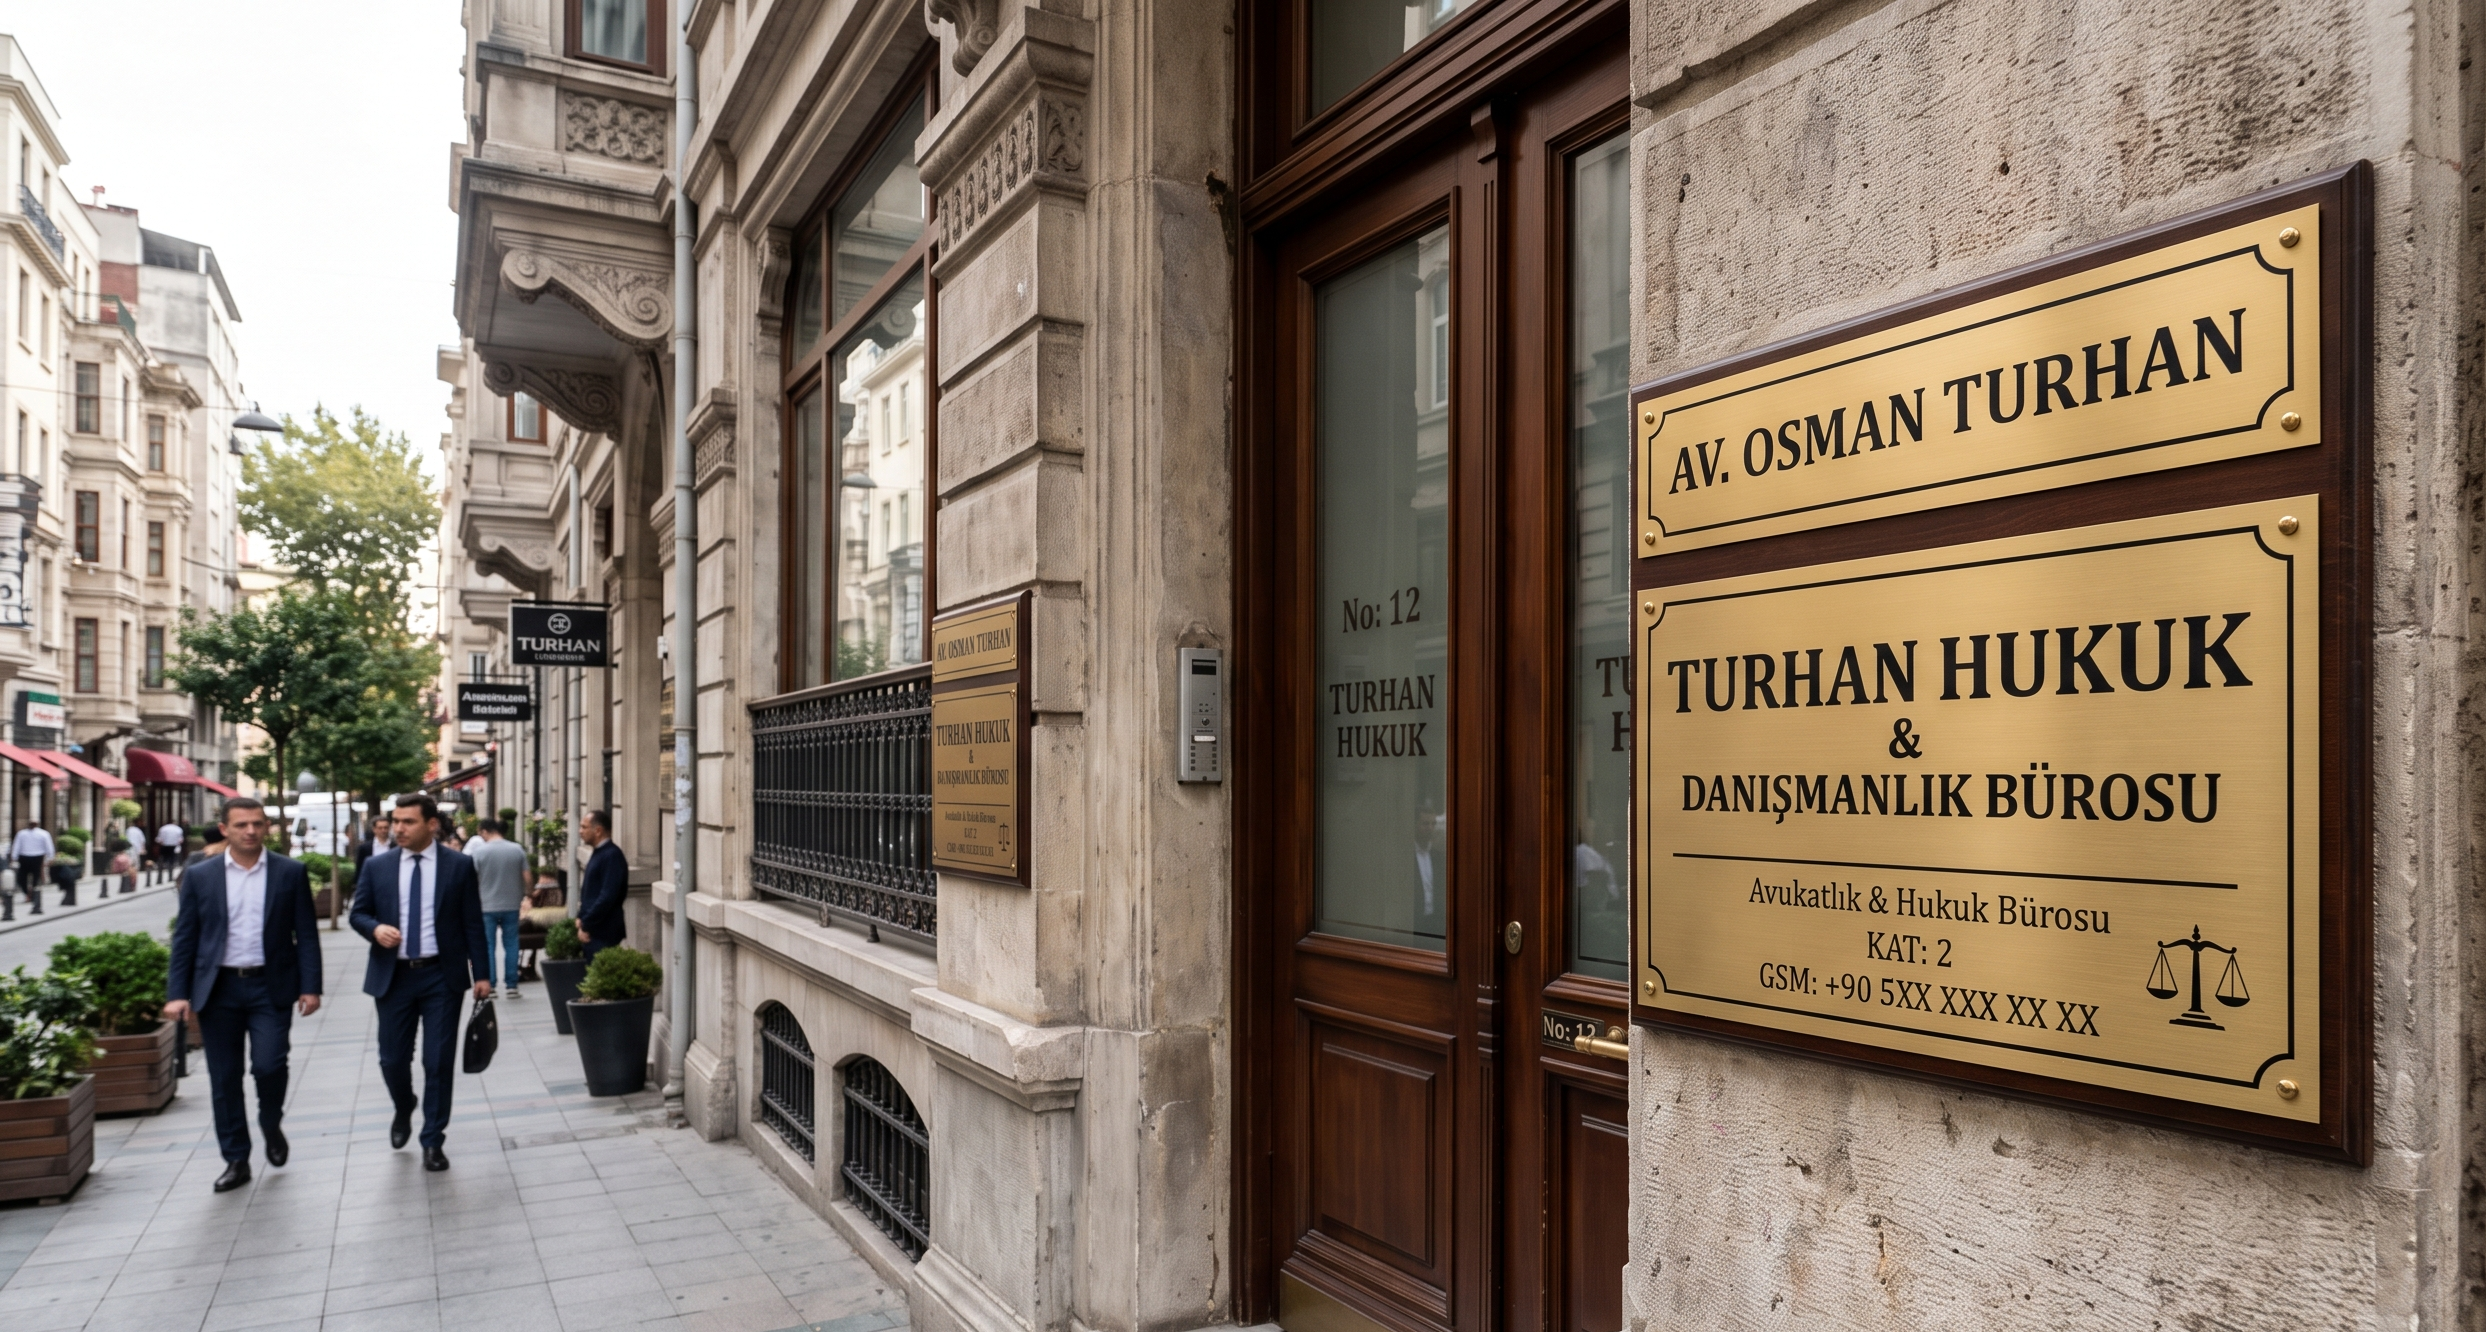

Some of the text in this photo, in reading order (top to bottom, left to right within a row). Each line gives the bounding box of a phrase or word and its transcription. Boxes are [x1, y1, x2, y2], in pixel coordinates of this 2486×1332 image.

[1668, 307, 2247, 495] AV. OSMAN TURHAN
[1343, 586, 1420, 633] No: 12
[517, 636, 601, 652] TURHAN
[948, 635, 975, 659] OSMAN
[976, 627, 1012, 653] TURHAN
[1668, 611, 2253, 713] TURHAN HUKUK
[1329, 674, 1435, 715] TURHAN
[936, 719, 1010, 746] TURHAN HUKUK
[1337, 722, 1427, 758] HUKUK
[1888, 717, 1923, 759] &
[1681, 762, 2222, 825] DANIŞMANLIK BÜROSU
[1748, 877, 2111, 934] Avukatlık & Hukuk Bürosu
[1867, 931, 1952, 968] KAT: 2
[1759, 962, 2101, 1038] GSM: +90 5XX XXX XX XX
[1543, 1015, 1571, 1041] No:
